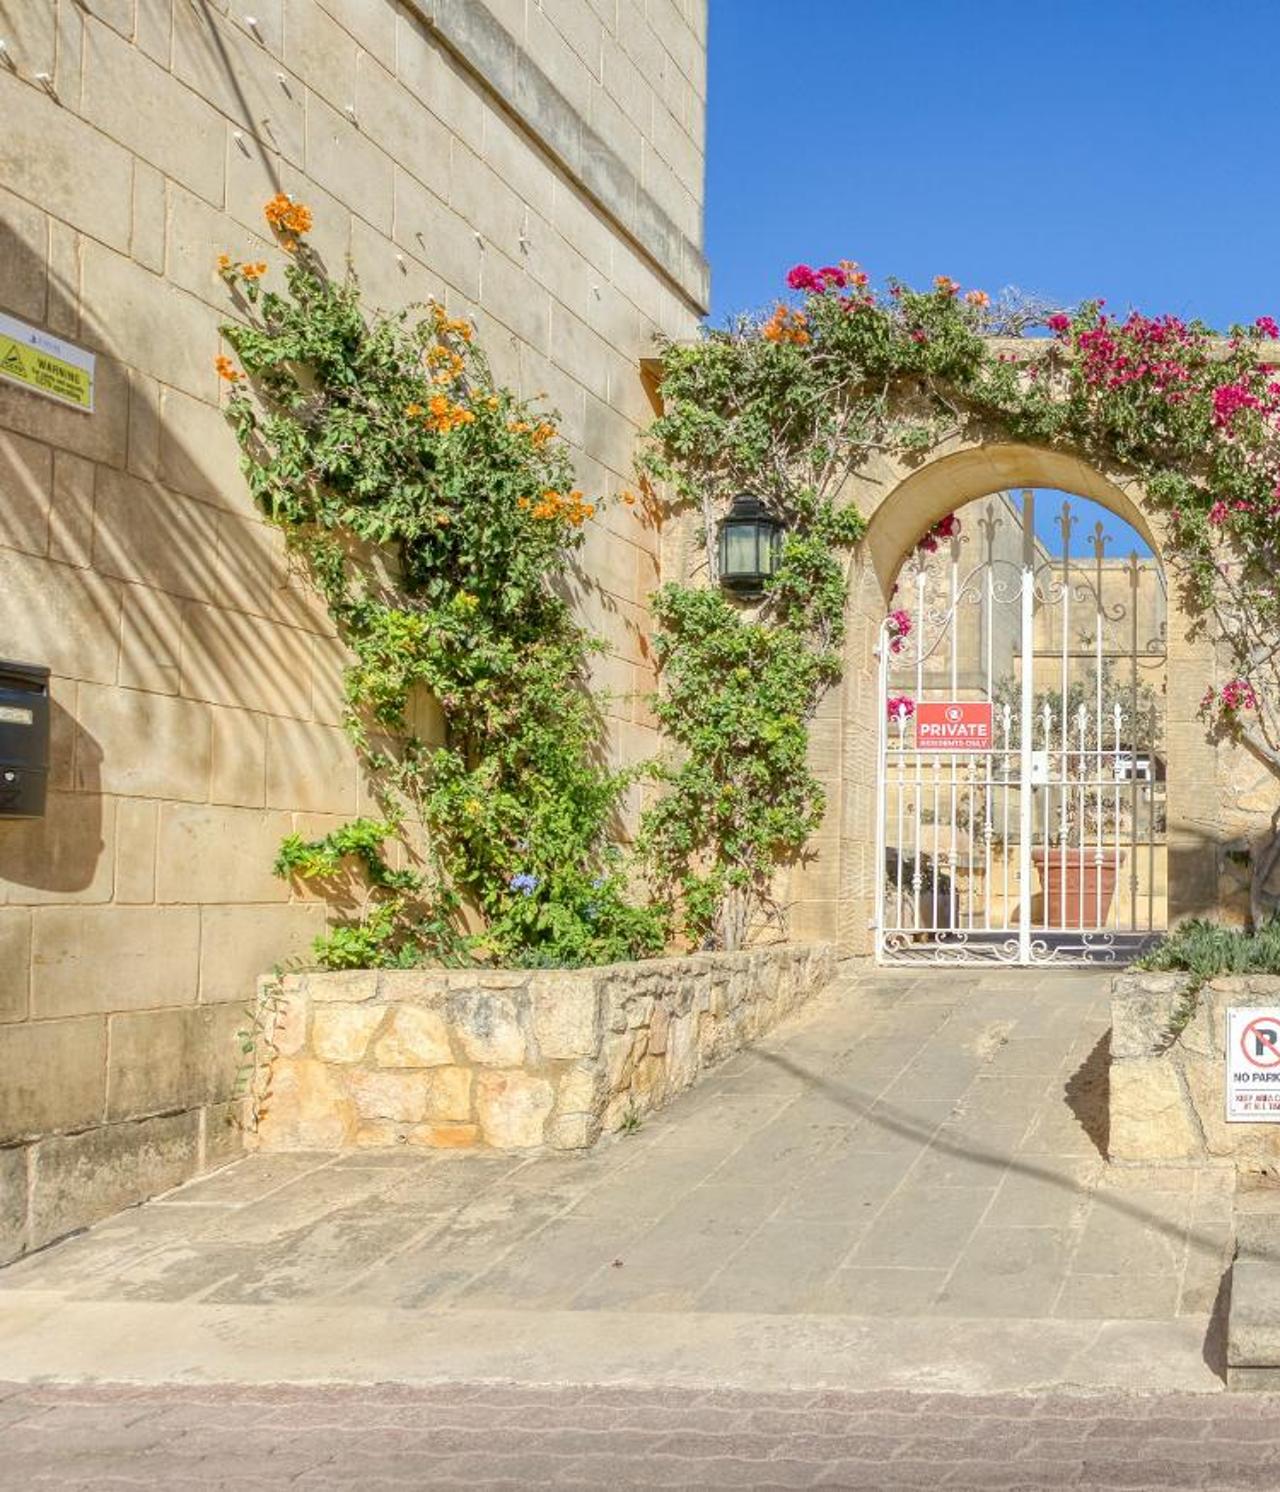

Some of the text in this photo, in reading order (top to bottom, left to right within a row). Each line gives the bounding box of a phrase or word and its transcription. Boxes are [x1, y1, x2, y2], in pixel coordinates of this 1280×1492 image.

[37, 358, 80, 384] WARNING
[920, 723, 987, 737] PRIVATE
[966, 739, 987, 747] ONLY
[1233, 1072, 1250, 1083] NO
